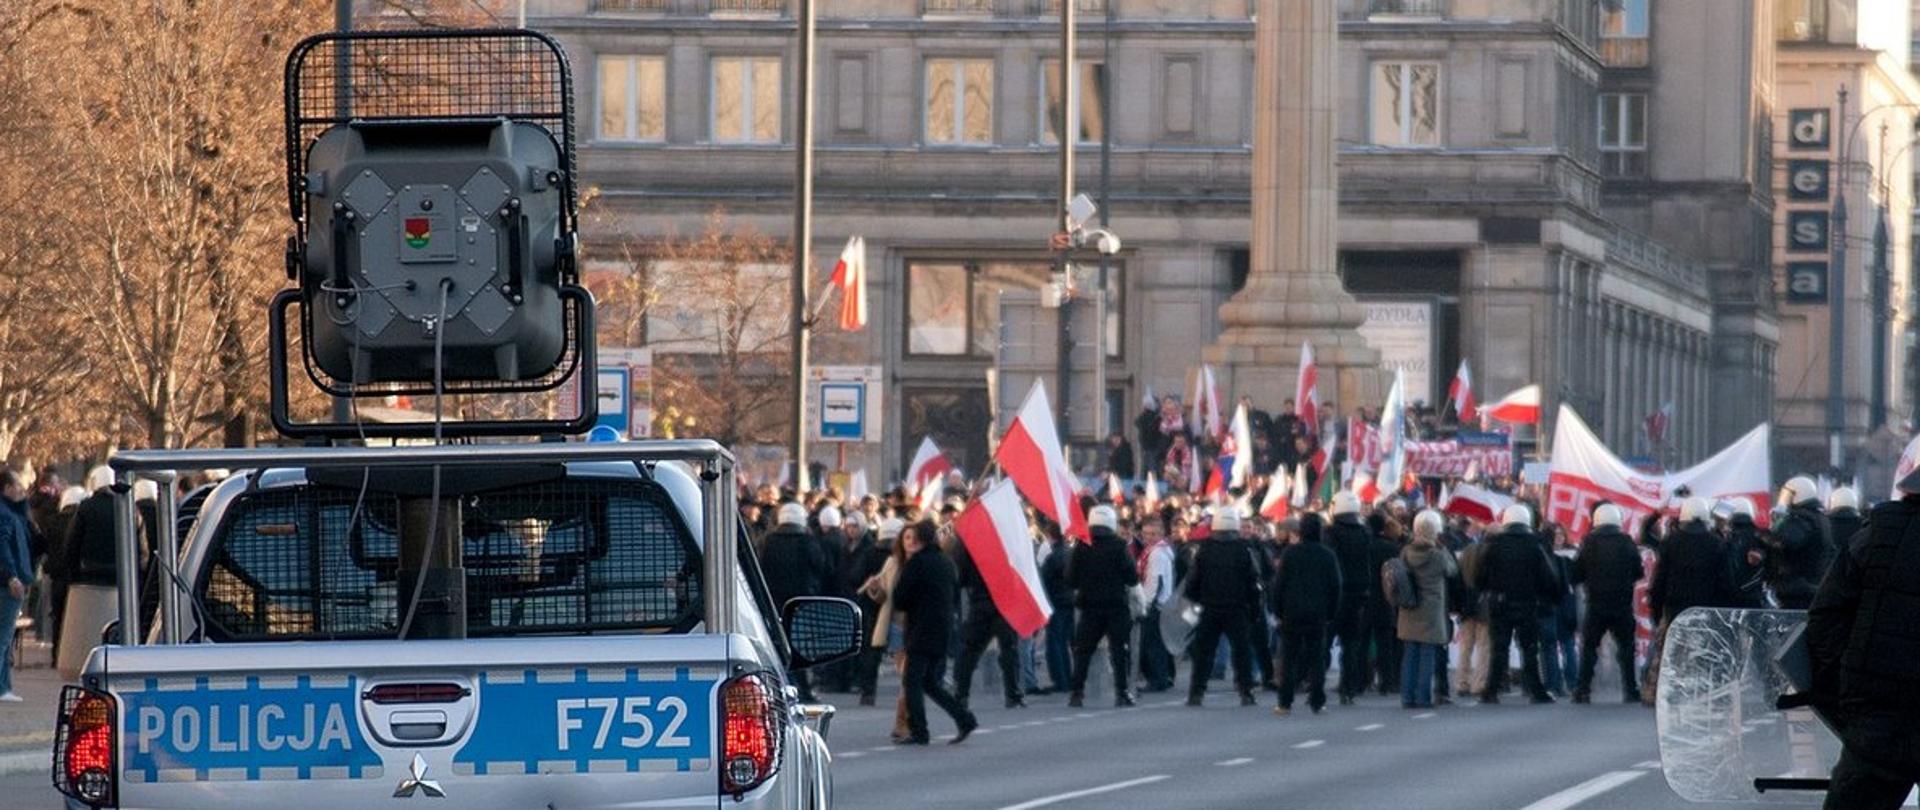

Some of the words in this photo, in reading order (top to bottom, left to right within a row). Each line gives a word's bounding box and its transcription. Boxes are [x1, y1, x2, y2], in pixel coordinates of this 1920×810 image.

[1793, 112, 1822, 293] desa
[1366, 307, 1425, 321] RZYDŁA
[138, 703, 352, 754] POLICJA
[557, 696, 691, 750] F752
